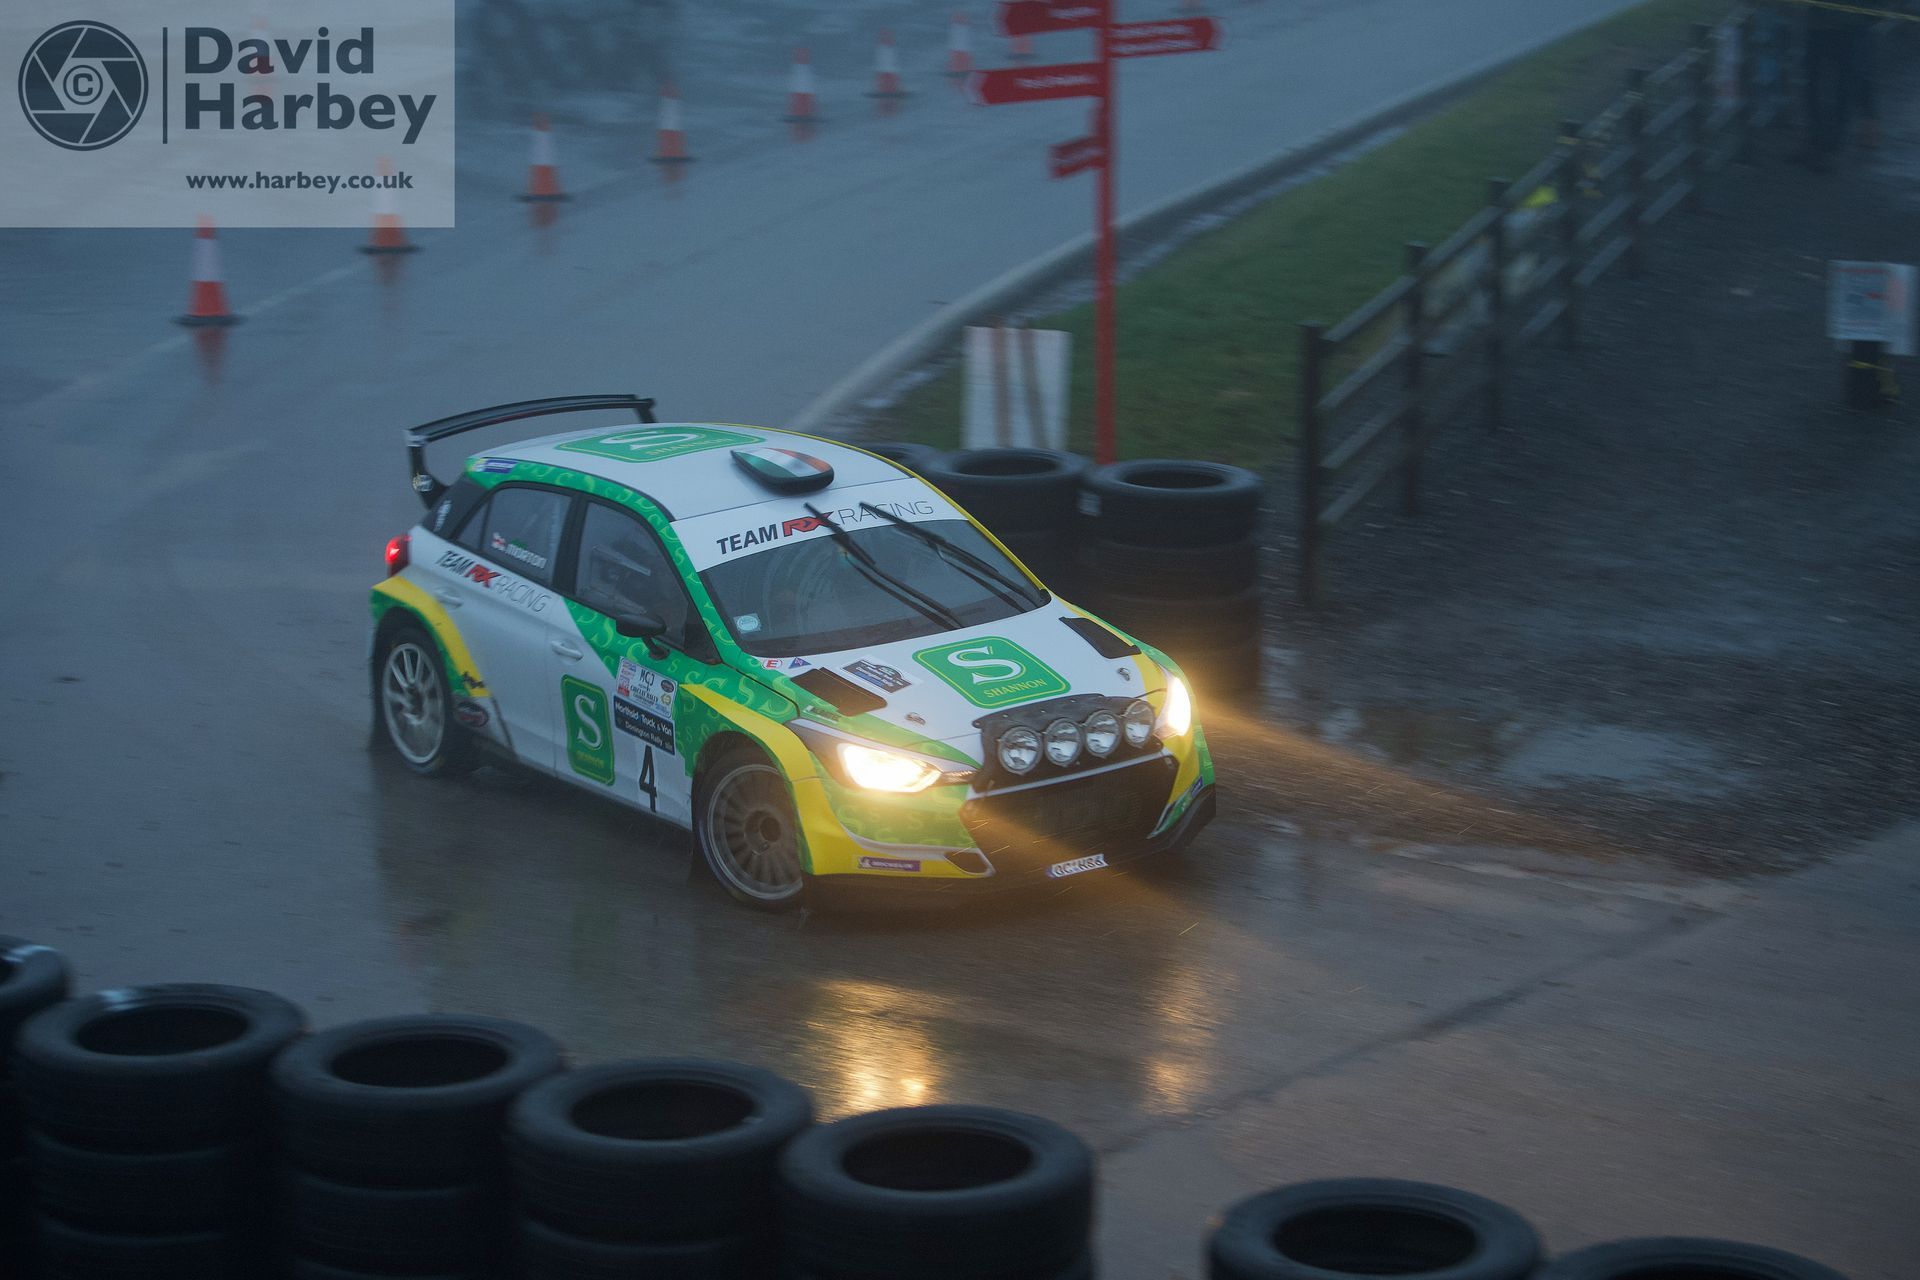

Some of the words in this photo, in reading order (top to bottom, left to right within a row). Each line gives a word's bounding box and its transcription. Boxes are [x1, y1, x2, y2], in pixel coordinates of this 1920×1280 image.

[716, 523, 778, 555] TEAM
[782, 510, 841, 538] RX
[838, 500, 935, 526] RACING
[436, 550, 475, 576] TEAM
[464, 563, 503, 589] RX
[495, 575, 553, 613] RACING
[766, 659, 779, 668] E
[946, 645, 1028, 686] S
[983, 677, 1048, 699] SHANNON
[573, 694, 603, 749] S
[641, 713, 656, 729] Truck
[661, 721, 673, 737] Van
[639, 745, 658, 813] 4
